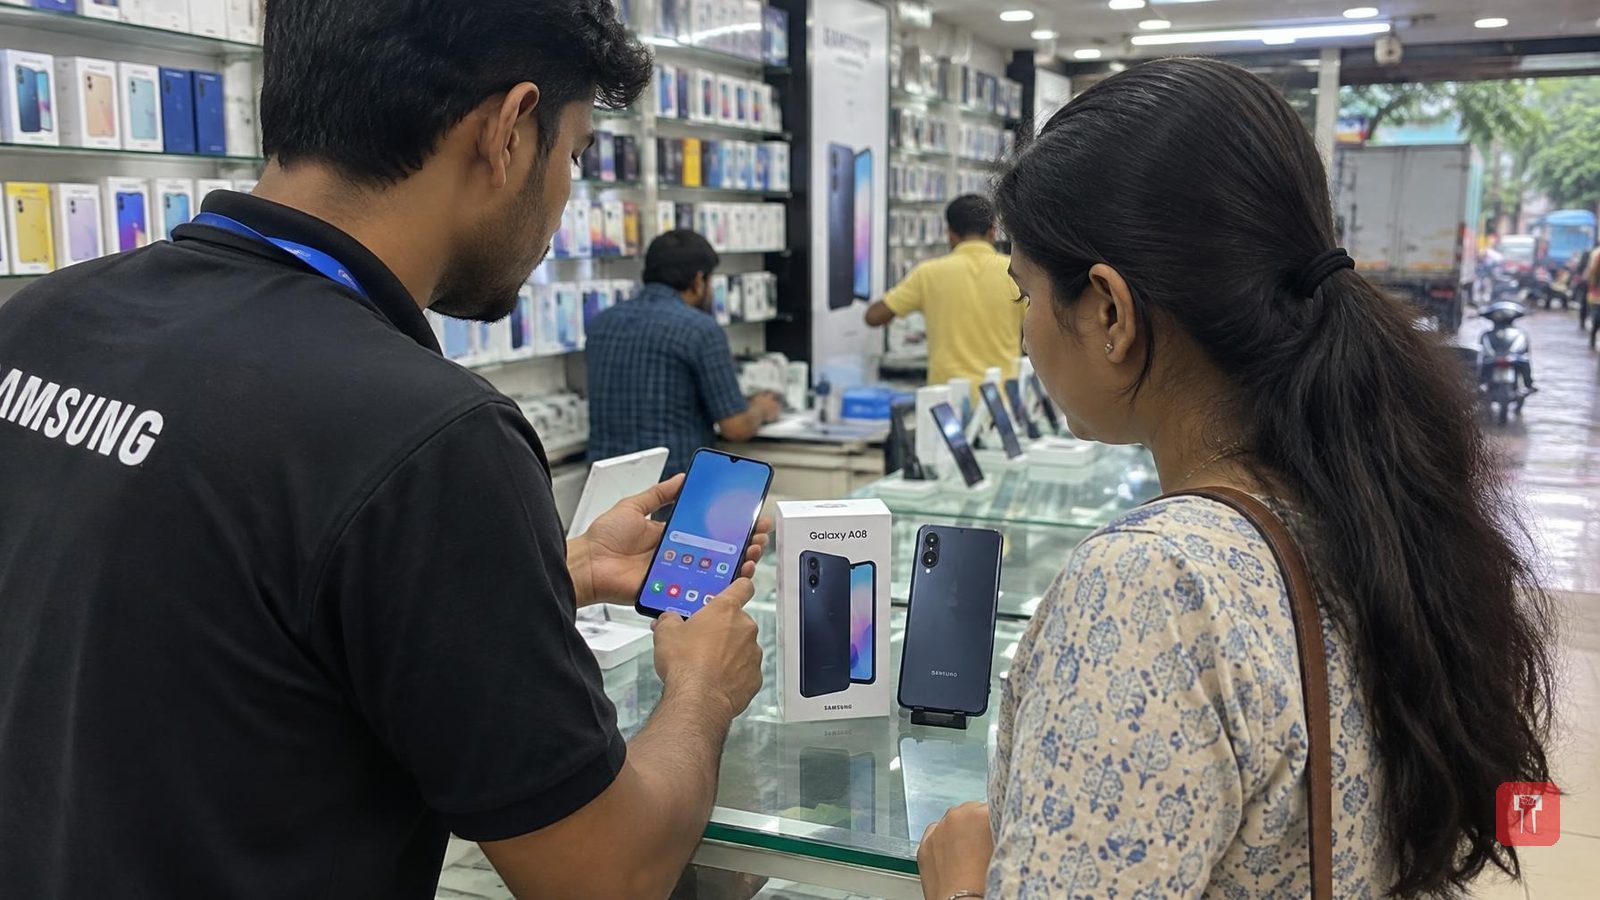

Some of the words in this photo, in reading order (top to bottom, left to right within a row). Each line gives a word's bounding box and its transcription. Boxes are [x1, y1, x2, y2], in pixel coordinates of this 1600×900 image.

[0, 363, 164, 466] AMSUNG
[809, 531, 847, 542] Galaxy
[848, 529, 868, 540] A08
[824, 703, 852, 711] SAMSUNG
